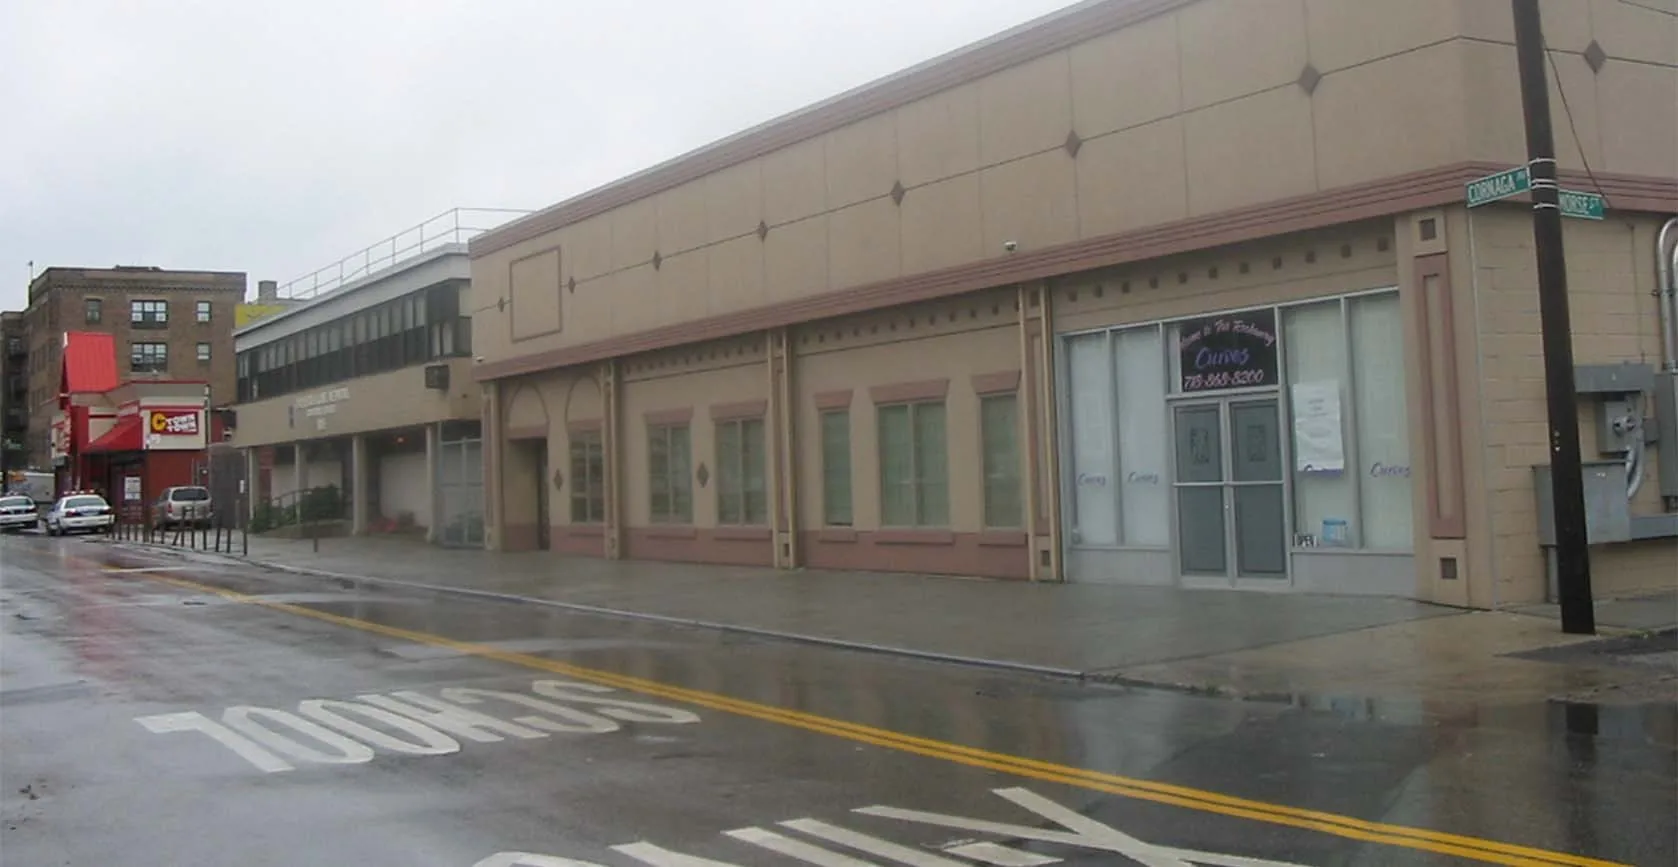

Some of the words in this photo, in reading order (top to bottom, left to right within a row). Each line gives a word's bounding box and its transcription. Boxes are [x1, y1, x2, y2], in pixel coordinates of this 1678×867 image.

[1468, 175, 1516, 203] CORNAGA
[1195, 346, 1250, 369] Curves
[135, 680, 701, 772] SCHOOL
